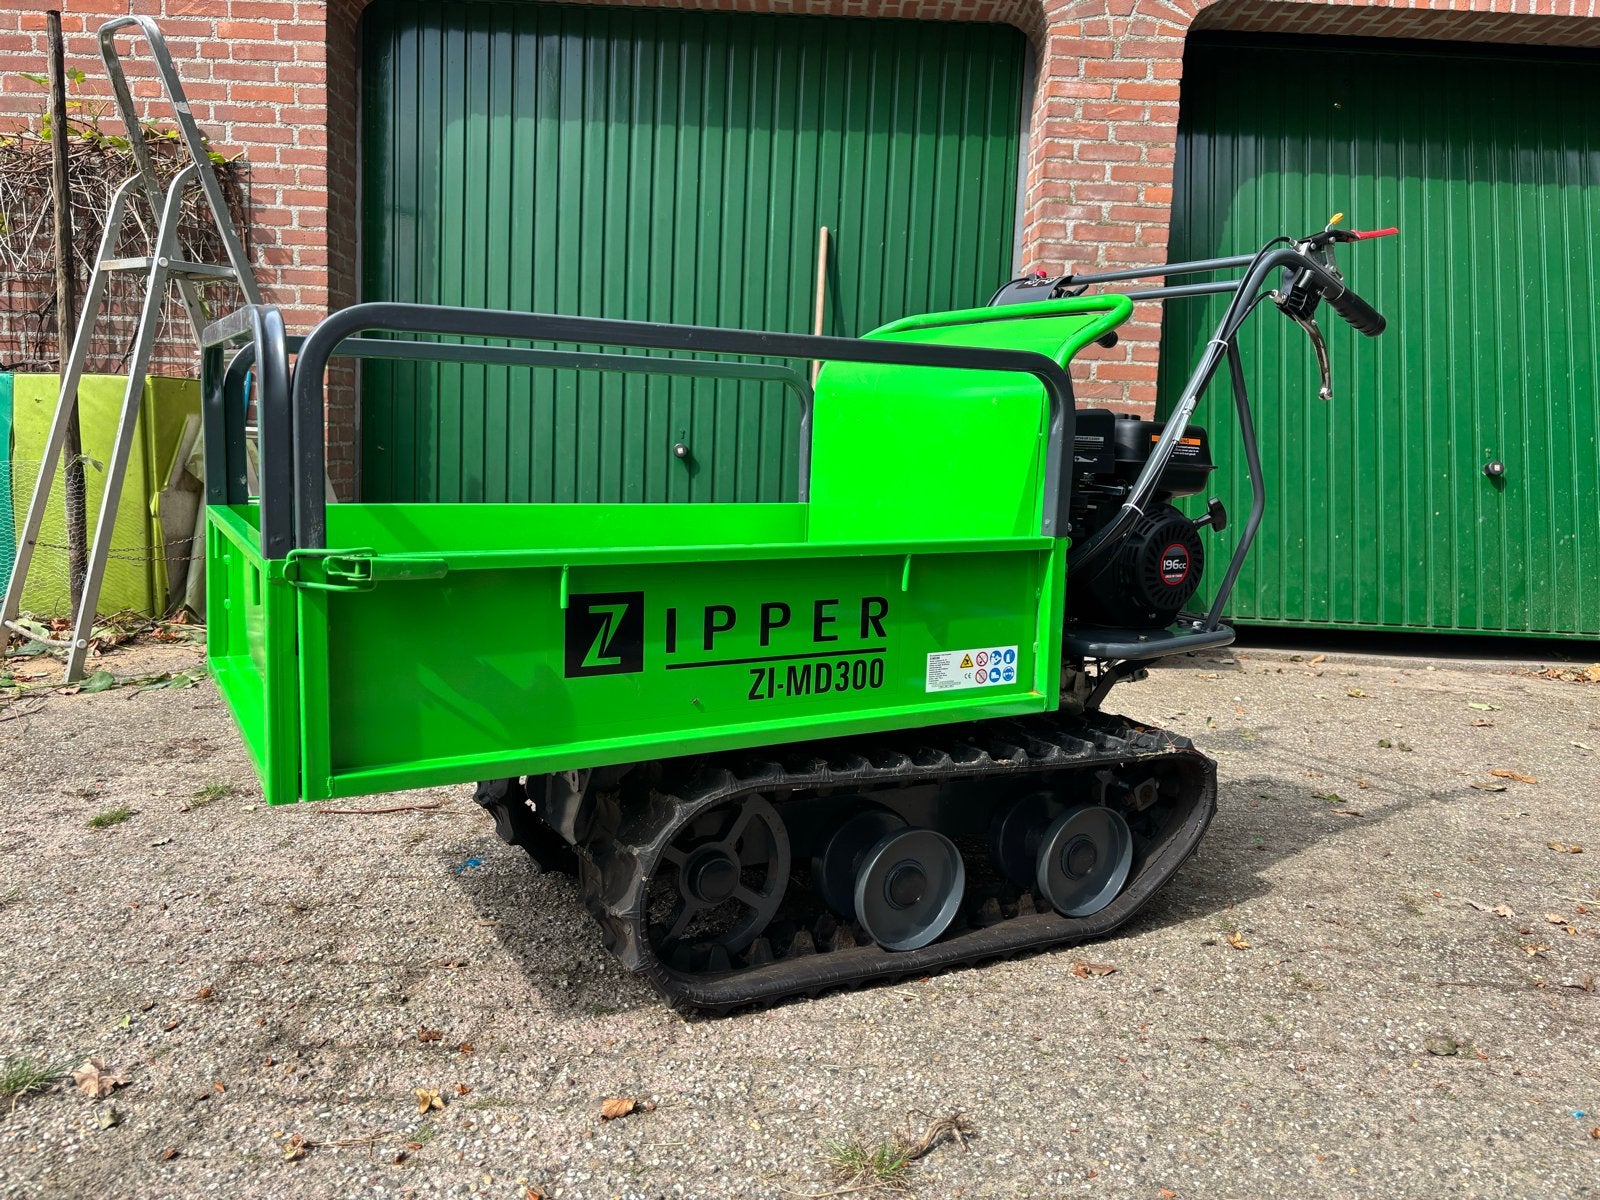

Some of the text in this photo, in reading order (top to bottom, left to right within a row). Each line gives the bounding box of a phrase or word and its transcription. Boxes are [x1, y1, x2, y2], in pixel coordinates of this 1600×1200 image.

[1163, 559, 1187, 571] 196cc
[580, 596, 889, 668] ZIPPER
[748, 658, 884, 701] ZI-MD300
